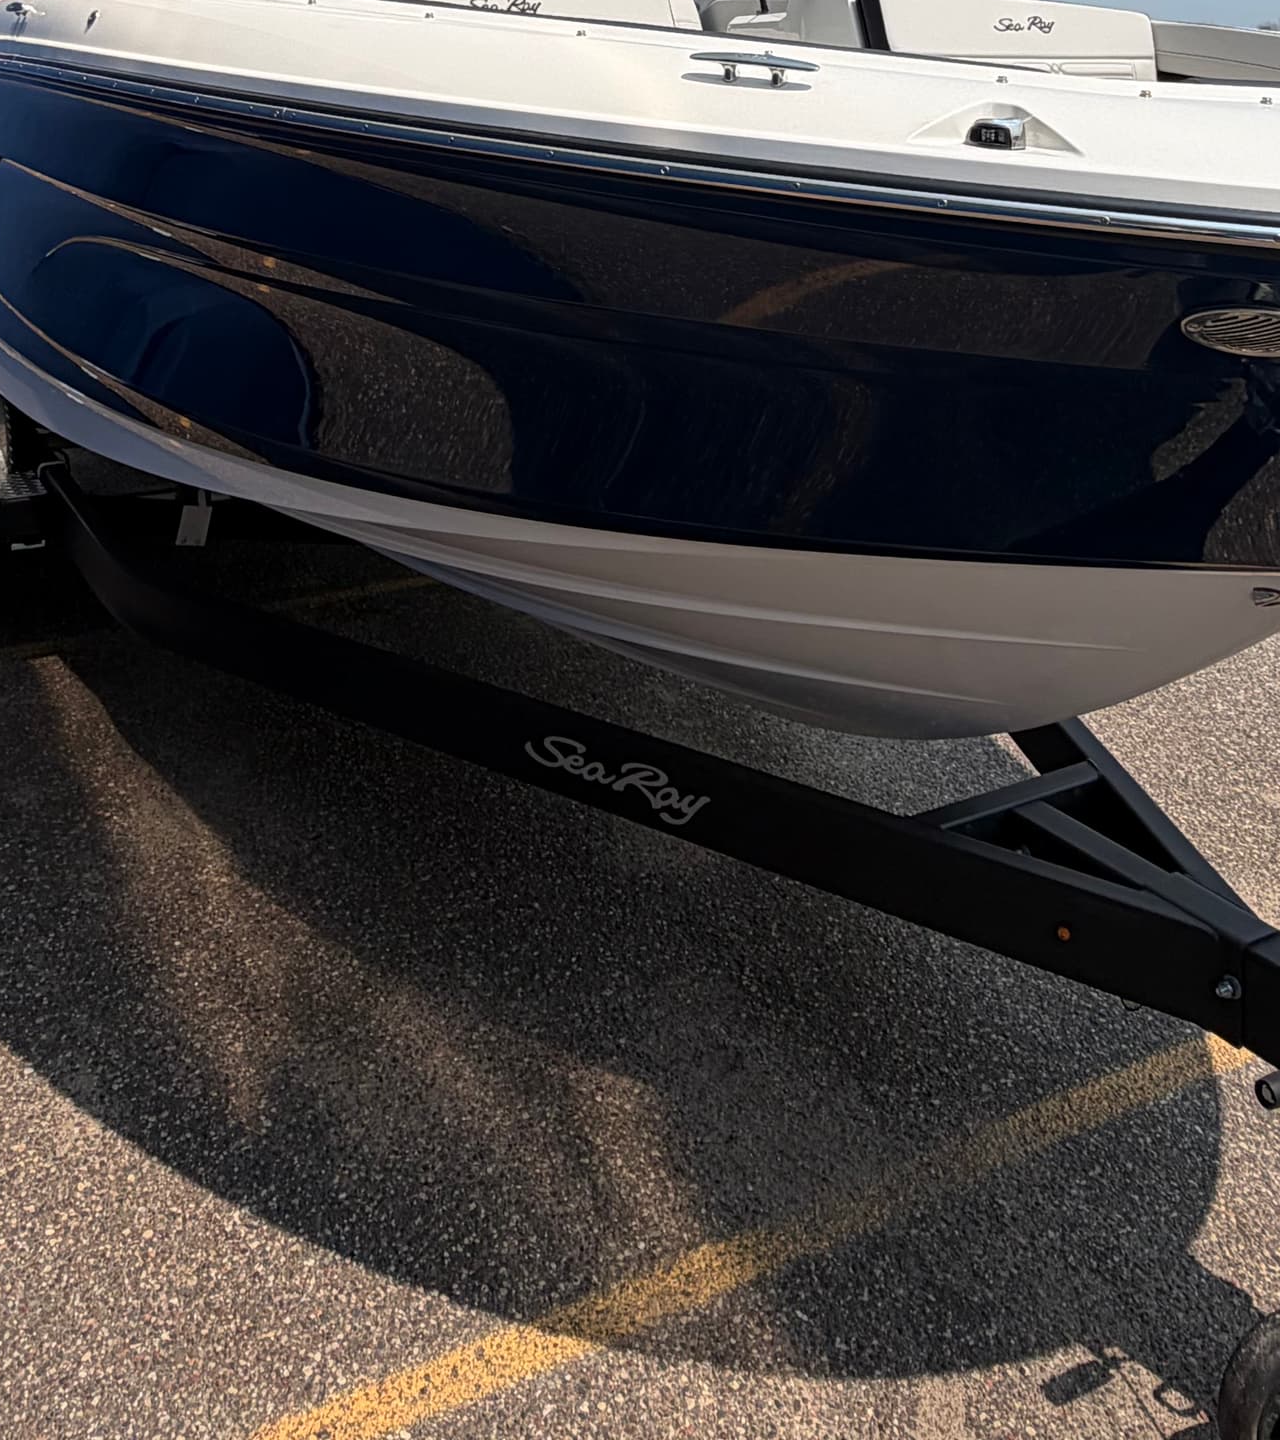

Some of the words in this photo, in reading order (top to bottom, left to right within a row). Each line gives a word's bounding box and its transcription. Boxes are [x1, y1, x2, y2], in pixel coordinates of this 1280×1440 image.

[993, 17, 1024, 32] Sea
[1027, 16, 1055, 34] Ray
[524, 736, 617, 784] Sea
[612, 762, 711, 825] Ray
